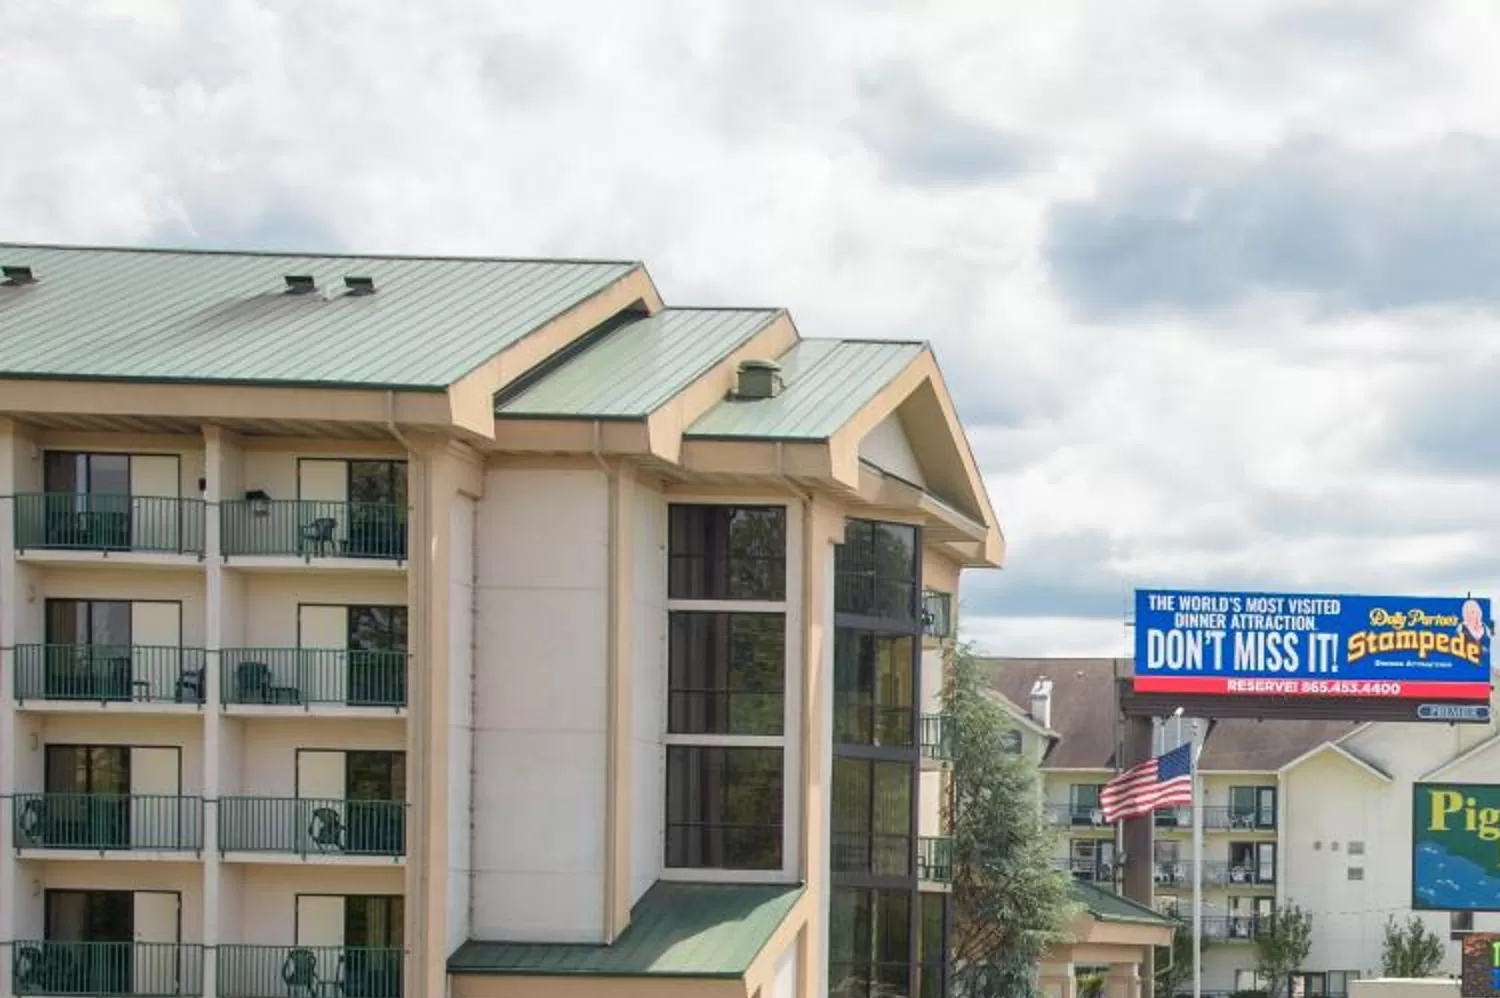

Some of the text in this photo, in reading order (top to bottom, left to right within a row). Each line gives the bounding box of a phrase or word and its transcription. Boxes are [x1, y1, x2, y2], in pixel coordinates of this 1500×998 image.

[1148, 595, 1341, 615] THE WORLD'S MOST VISITED
[1175, 613, 1226, 629] DINNER
[1147, 629, 1339, 673] DON'T MISS IT!
[1347, 630, 1480, 664] Stampede
[1227, 680, 1298, 693] RESERVE!
